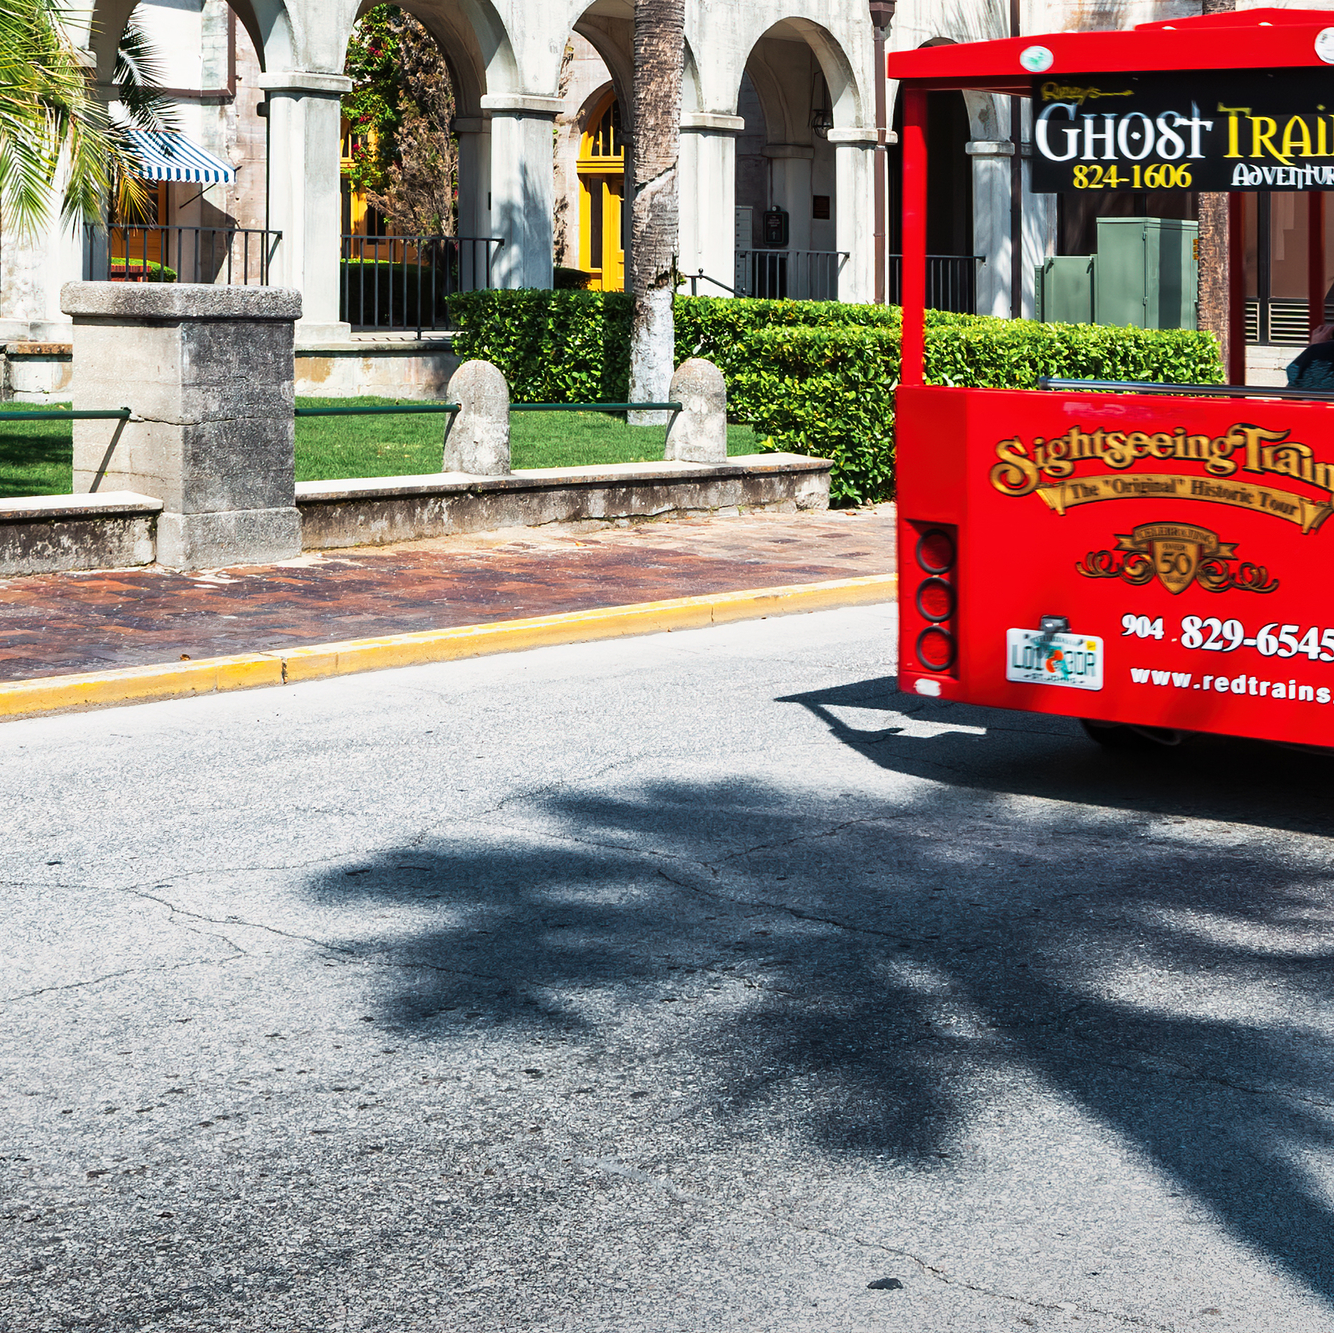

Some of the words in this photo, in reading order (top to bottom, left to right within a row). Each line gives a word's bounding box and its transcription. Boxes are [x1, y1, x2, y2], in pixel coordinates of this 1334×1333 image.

[1035, 100, 1213, 162] GHOST
[1073, 162, 1192, 189] 824-1606
[990, 425, 1238, 497] Sightseeing
[1070, 483, 1099, 500] The
[1190, 479, 1255, 504] Historic
[1259, 492, 1299, 516] Tour
[1161, 553, 1192, 576] 50
[1120, 613, 1164, 640] 904
